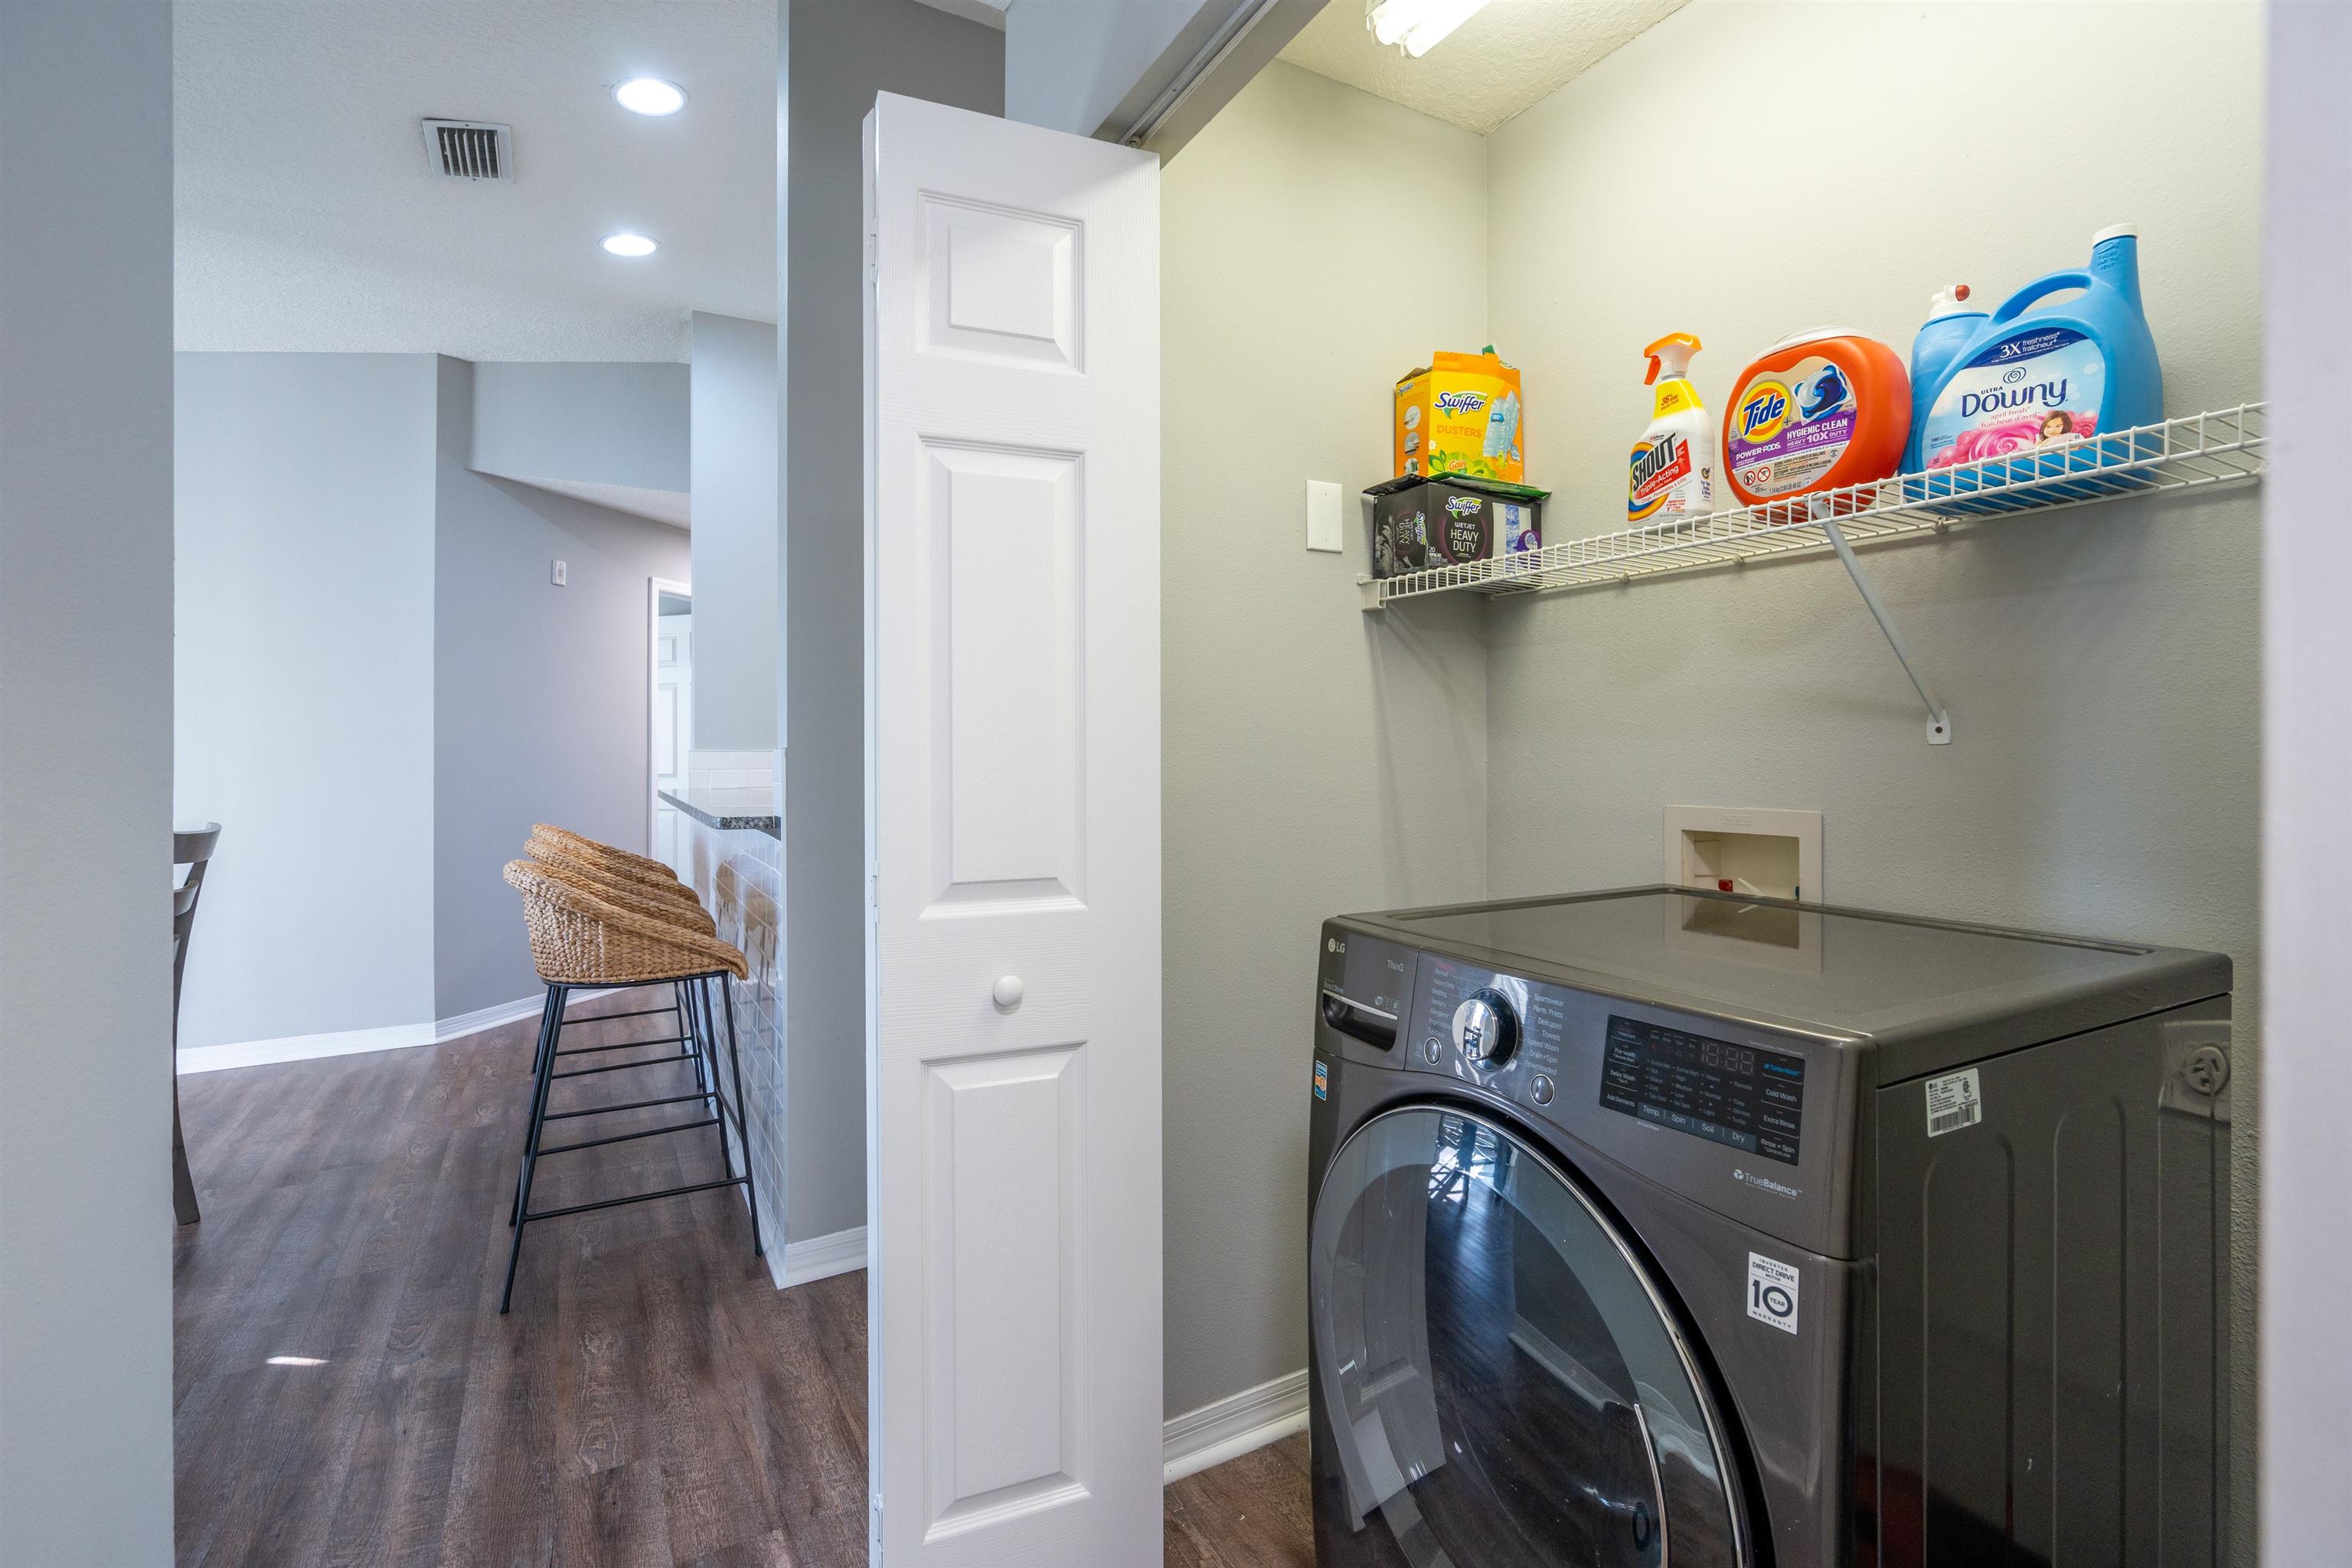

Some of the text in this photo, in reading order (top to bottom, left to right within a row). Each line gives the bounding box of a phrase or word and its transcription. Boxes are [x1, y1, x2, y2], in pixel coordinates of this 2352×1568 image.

[2023, 333, 2058, 346] freshness
[2000, 341, 2021, 358] 3X
[1981, 386, 2003, 394] ULTRA
[1433, 391, 1485, 415] Swiffer
[1962, 378, 2067, 418] Downy
[1743, 393, 1786, 437] Tide
[1436, 424, 1482, 438] DUSTERS
[1787, 418, 1847, 439] HYGIENIC CLEAN
[1787, 439, 1806, 447] HEAVY
[1807, 431, 1828, 443] 10X
[1449, 459, 1466, 472] Gain
[1632, 432, 1677, 492] SHOUT
[1641, 466, 1679, 496] Triple-Acting
[1446, 496, 1481, 516] Swiffer
[1415, 511, 1425, 545] Swiffer
[1451, 528, 1479, 542] HEAVY
[1453, 541, 1476, 553] DUTY
[1387, 959, 1404, 972] ThinQ
[1534, 993, 1564, 1007] Sportswear
[1533, 1004, 1563, 1018] Perm. Press
[1537, 1017, 1562, 1030] Delicates
[1542, 1030, 1561, 1041] Towels
[1527, 1037, 1560, 1052] Speed Wash
[1614, 1047, 1635, 1058] Pre-wash
[1524, 1060, 1557, 1076] Downloaded
[1610, 1070, 1635, 1082] Delay Wash
[1615, 1096, 1635, 1107] Garments
[1766, 1089, 1797, 1102] Cold Wash
[1642, 1105, 1661, 1117] Temp.
[1671, 1113, 1686, 1125] Spin
[1763, 1115, 1795, 1129] Extra Rinse
[1702, 1122, 1715, 1133] Soil
[1732, 1132, 1746, 1144] Dry
[1761, 1138, 1777, 1148] Rinse
[1782, 1145, 1795, 1155] Spin
[1745, 1172, 1798, 1197] TrueBalance
[1753, 1262, 1795, 1282] DIRECT DRIVE
[1759, 1259, 1788, 1272] INVERTER
[1766, 1273, 1781, 1282] MOTOR
[1753, 1279, 1793, 1318] 10
[1769, 1297, 1785, 1308] YEAR
[1753, 1310, 1792, 1328] WARRANTY
